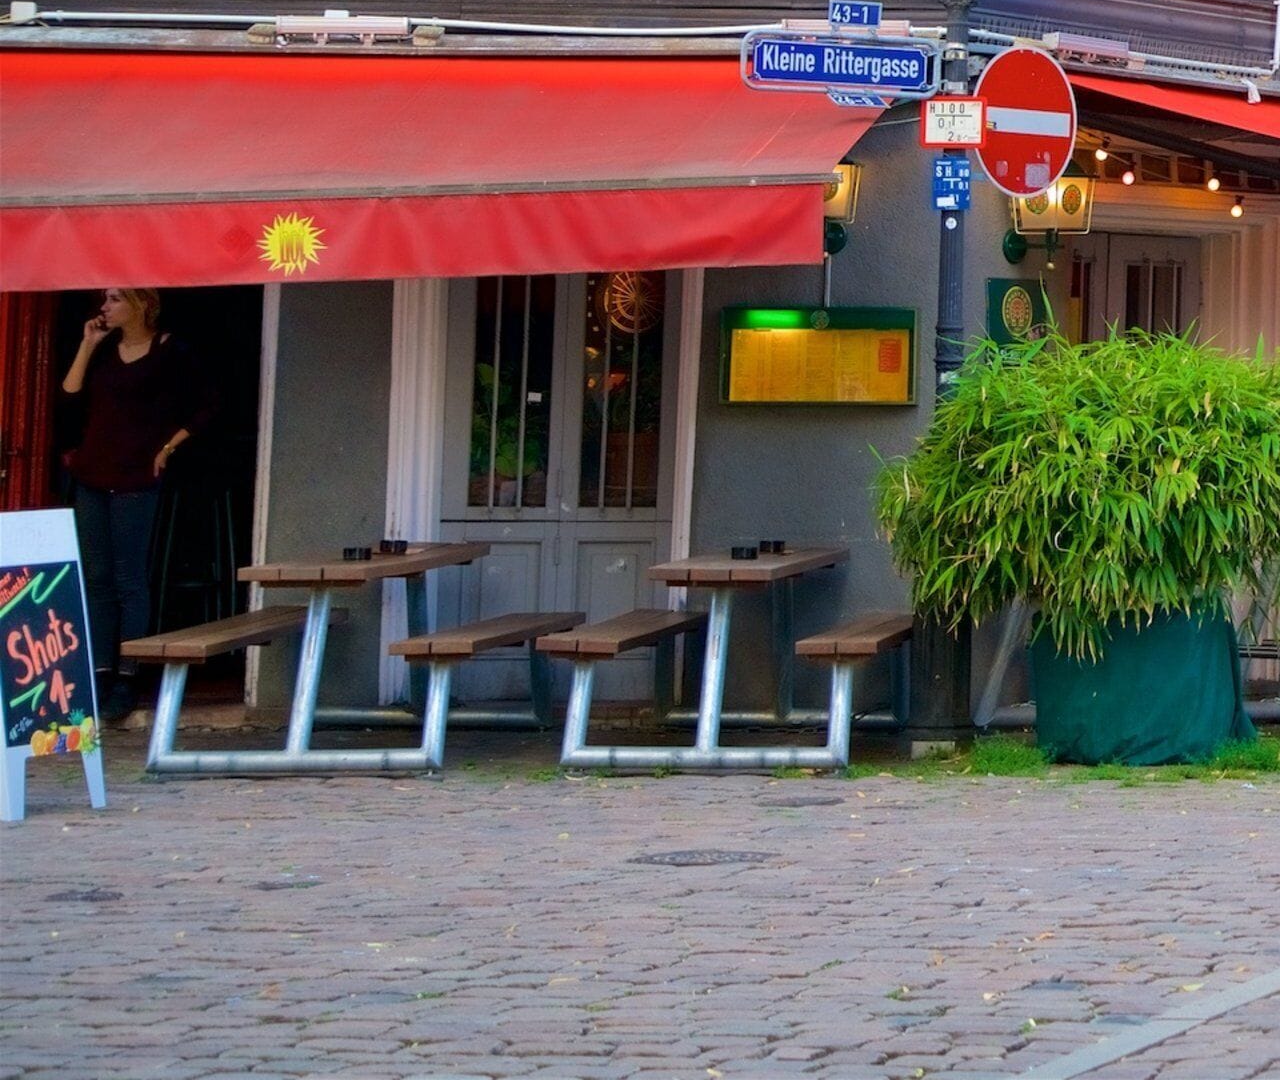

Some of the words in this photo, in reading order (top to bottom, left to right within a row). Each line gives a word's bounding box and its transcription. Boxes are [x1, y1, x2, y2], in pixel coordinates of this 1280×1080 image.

[832, 3, 869, 24] 43-1
[762, 44, 816, 74] Kleine
[823, 48, 919, 83] Rittergasse
[7, 608, 80, 685] Shots
